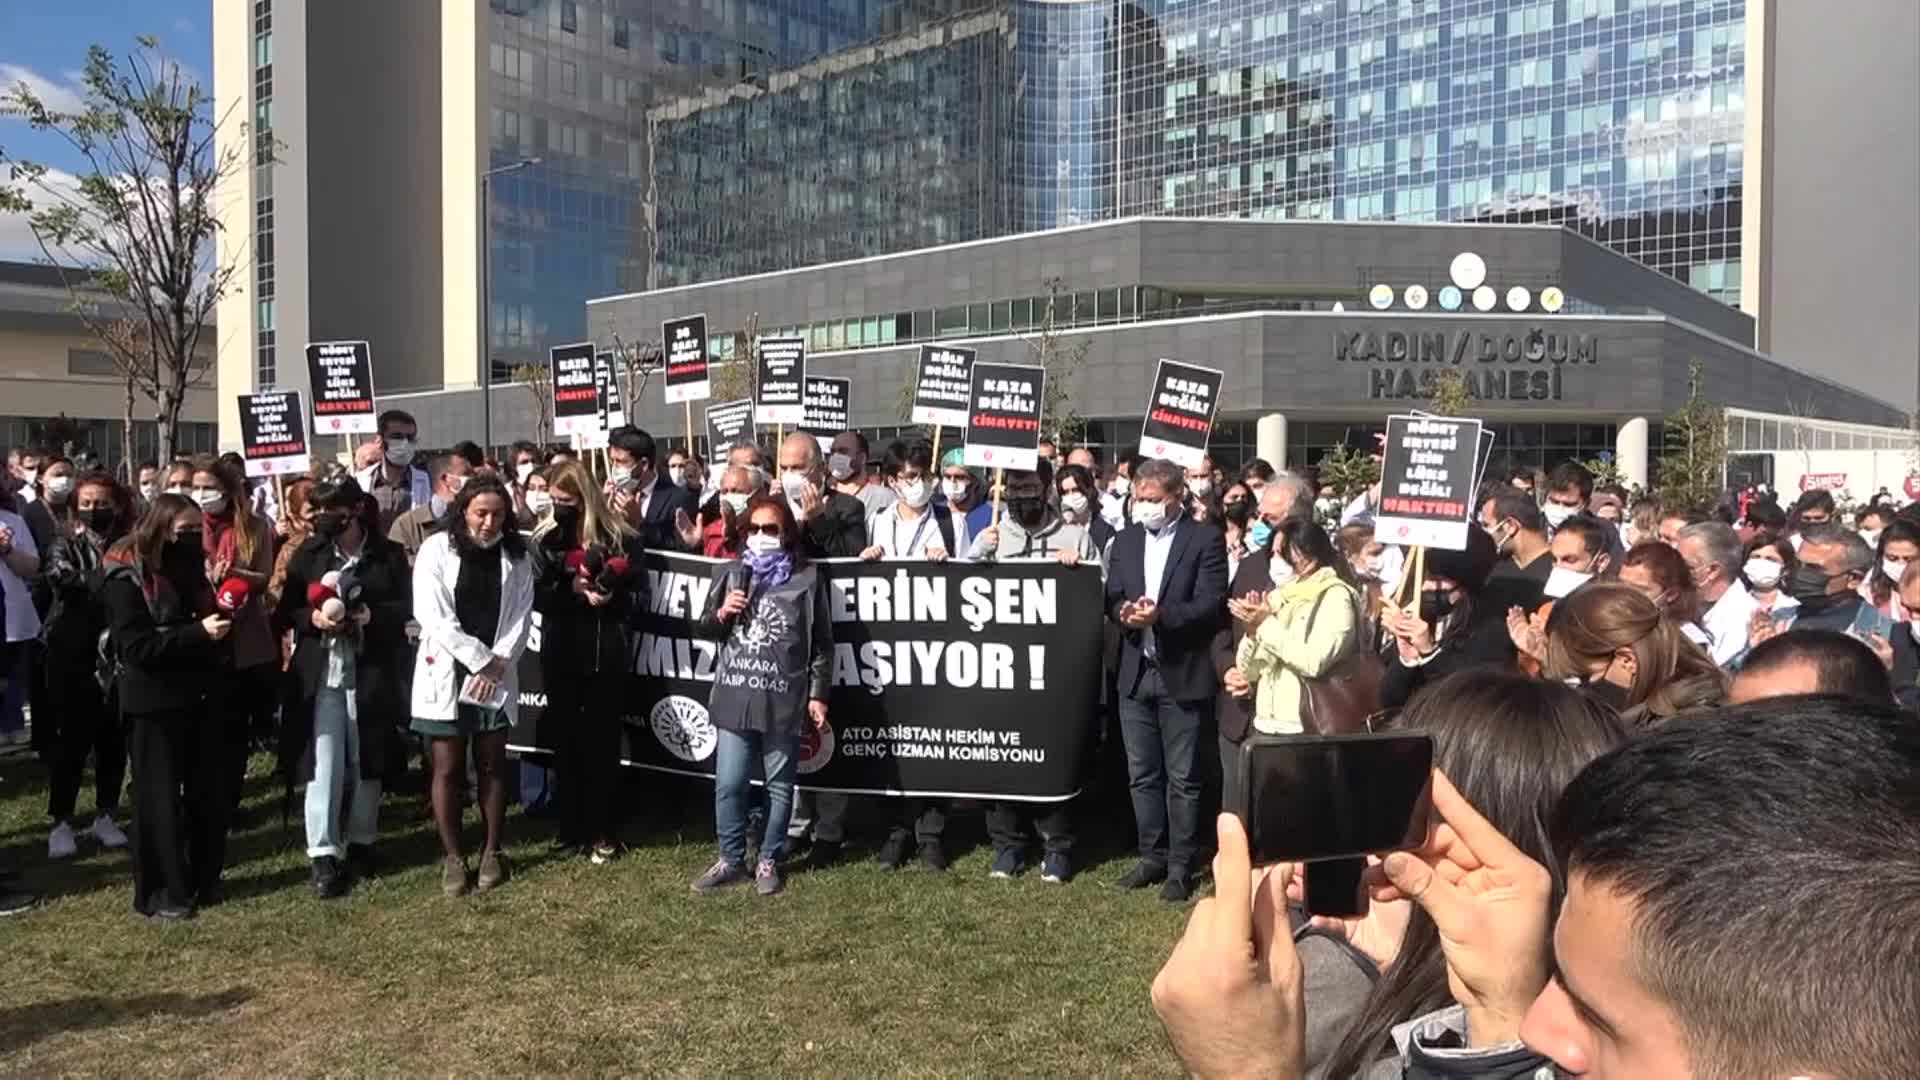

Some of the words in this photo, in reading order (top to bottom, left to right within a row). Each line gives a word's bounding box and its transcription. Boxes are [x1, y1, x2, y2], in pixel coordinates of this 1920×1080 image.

[1334, 329, 1444, 363] KADIN
[1477, 327, 1597, 364] DOĞUM
[559, 357, 589, 371] KAZA
[931, 350, 964, 365] KÖLE
[925, 365, 968, 379] DEĞİL!
[983, 378, 1033, 395] KAZA
[1165, 376, 1209, 397] KAZA
[977, 393, 1036, 414] DEĞİL!
[1158, 392, 1210, 416] DEĞİL!
[971, 414, 1039, 430] CİNAYET!
[1151, 408, 1209, 433] CİNAYET!
[1407, 420, 1460, 437] NÖBET
[1398, 481, 1453, 499] DEĞİL!
[959, 575, 1057, 632] ŞEN
[632, 630, 717, 682] MIZ
[1028, 644, 1046, 691] !
[729, 658, 779, 683] ANKARA
[516, 692, 548, 707] NKA
[842, 727, 873, 742] ATO
[876, 723, 942, 743] ASİSTAN
[945, 727, 995, 745] HEKİM
[998, 731, 1021, 747] VE
[843, 743, 887, 759] GENÇ
[890, 743, 945, 760] UZMAN
[948, 744, 1046, 764] KOMİSYONU
